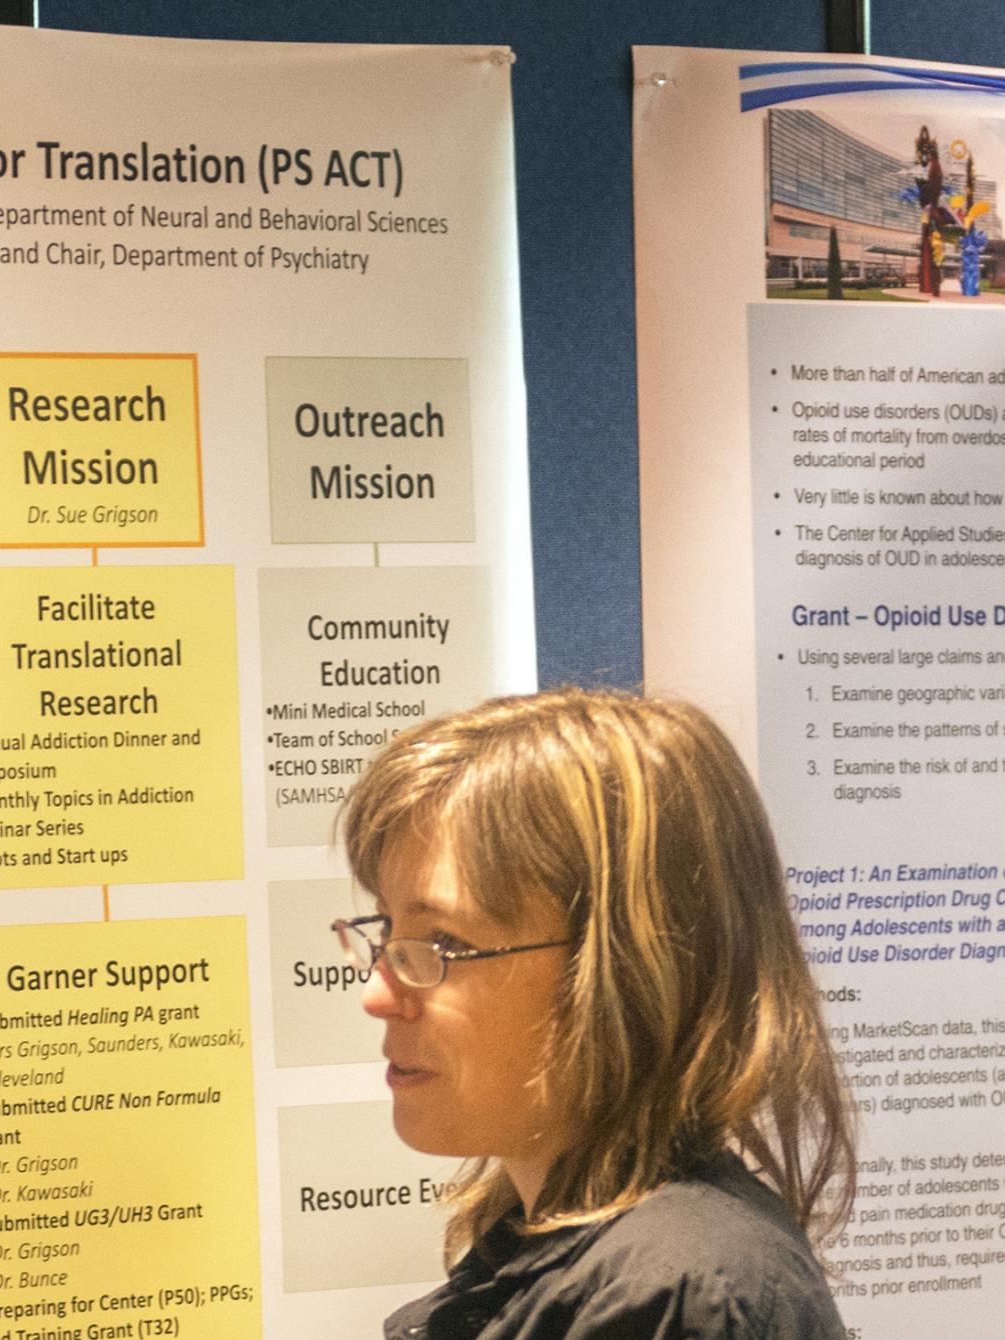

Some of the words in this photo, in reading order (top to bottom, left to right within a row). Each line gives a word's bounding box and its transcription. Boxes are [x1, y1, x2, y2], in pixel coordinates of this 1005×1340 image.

[36, 141, 245, 185] Translation
[258, 144, 314, 195] (PS
[323, 148, 404, 198] ACT)
[113, 204, 134, 227] of
[141, 206, 208, 228] Neural
[215, 207, 252, 229] and
[259, 207, 362, 233] Behavioral
[367, 211, 448, 234] Sciences
[0, 241, 39, 264] and
[45, 241, 106, 270] Chair,
[112, 243, 239, 271] Department
[244, 245, 265, 268] of
[270, 246, 370, 276] Psychiatry
[791, 364, 828, 381] More
[833, 366, 864, 381] than
[869, 367, 895, 382] half
[900, 367, 913, 383] of
[917, 368, 984, 384] American
[8, 384, 166, 422] Research
[792, 401, 839, 421] Opioid
[844, 406, 870, 419] use
[874, 404, 940, 420] disorders
[945, 404, 998, 424] (OUDs)
[294, 401, 444, 438] Outreach
[23, 448, 159, 485] Mission
[793, 452, 875, 468] educational
[880, 453, 925, 471] period
[310, 463, 435, 500] Mission
[794, 488, 827, 508] Very
[831, 490, 859, 504] little
[864, 492, 875, 505] is
[880, 491, 925, 505] known
[930, 490, 970, 506] about
[974, 491, 1003, 506] how
[28, 506, 50, 524] Dr.
[57, 505, 87, 524] Sue
[93, 505, 158, 527] Grigson
[37, 592, 156, 622] Facilitate
[792, 605, 849, 626] Grant
[874, 605, 941, 631] Opioid
[948, 606, 986, 626] Use
[307, 612, 450, 645] Community
[10, 638, 182, 670] Translational
[321, 659, 440, 686] Education
[40, 686, 158, 717] Research
[806, 686, 818, 701] 1.
[832, 685, 893, 701] Examine
[897, 686, 975, 705] geographic
[273, 703, 307, 720] Mini
[312, 702, 371, 719] Medical
[376, 700, 425, 717] School
[31, 732, 108, 749] Addiction
[114, 731, 167, 747] Dinner
[172, 729, 200, 746] and
[276, 761, 316, 776] ECHO
[321, 758, 363, 775] SBIRT
[44, 790, 93, 810] Topics
[98, 789, 112, 805] in
[118, 787, 193, 804] Addiction
[834, 784, 901, 804] diagnosis
[786, 867, 844, 887] Project
[851, 866, 864, 882] 1:
[869, 866, 891, 881] An
[897, 864, 998, 881] Examination
[7, 965, 97, 991] Garner
[105, 958, 210, 992] Support
[68, 1008, 129, 1027] Healing
[134, 1006, 153, 1022] PA
[159, 1005, 199, 1025] grant
[853, 1020, 938, 1038] MarketScan
[942, 1020, 976, 1035] data,
[300, 1185, 412, 1213] Resource
[75, 1206, 153, 1227] UG3/UH3
[158, 1204, 202, 1221] Grant
[71, 1296, 94, 1312] for
[99, 1294, 153, 1311] Center
[159, 1287, 205, 1309] (P50);
[210, 1284, 253, 1301] PPGs;
[872, 1282, 904, 1298] prior
[908, 1275, 982, 1293] enrollment
[87, 1323, 133, 1340] Grant
[138, 1317, 179, 1340] (T32)
